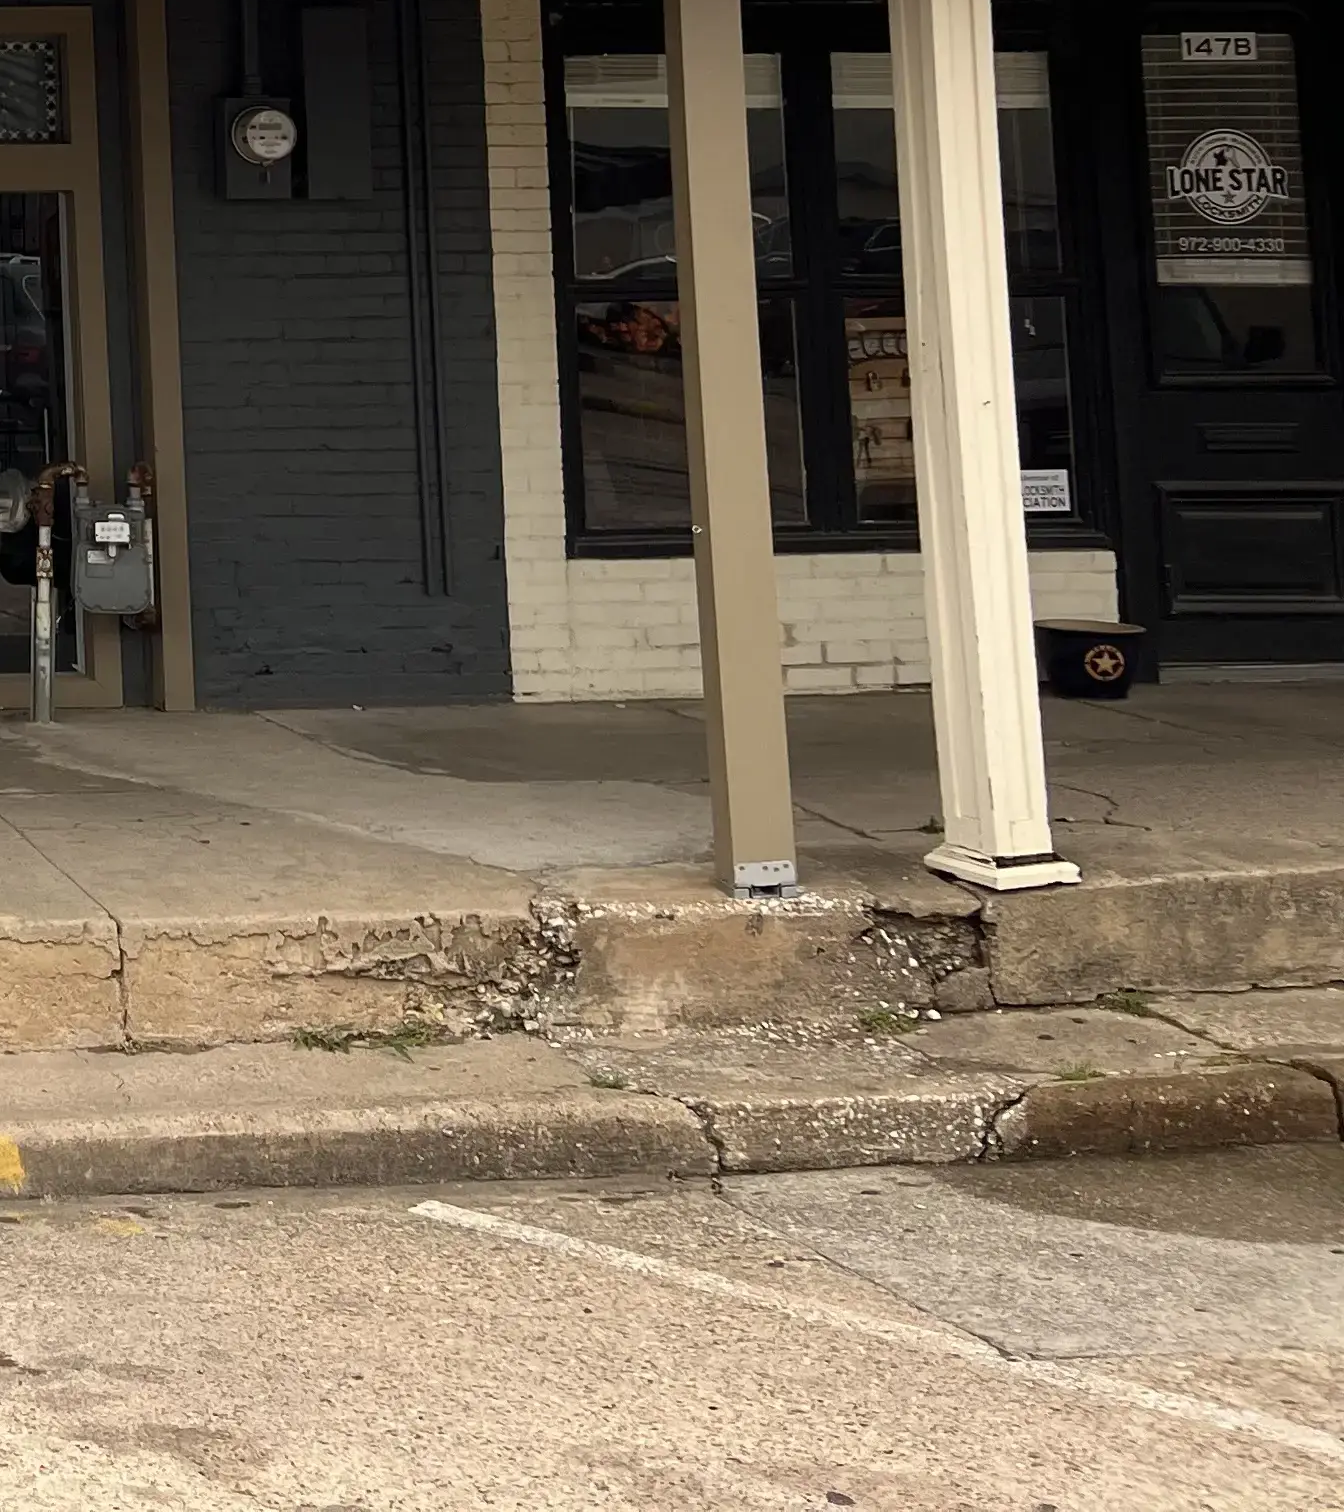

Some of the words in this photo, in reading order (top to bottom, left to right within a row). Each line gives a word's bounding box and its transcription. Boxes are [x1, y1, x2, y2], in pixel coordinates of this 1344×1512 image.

[1184, 37, 1252, 56] 147B
[1169, 168, 1224, 197] LONE
[1228, 168, 1288, 197] STAR
[1194, 192, 1264, 219] LOCKSMITH
[1178, 236, 1285, 252] 972-900-4330
